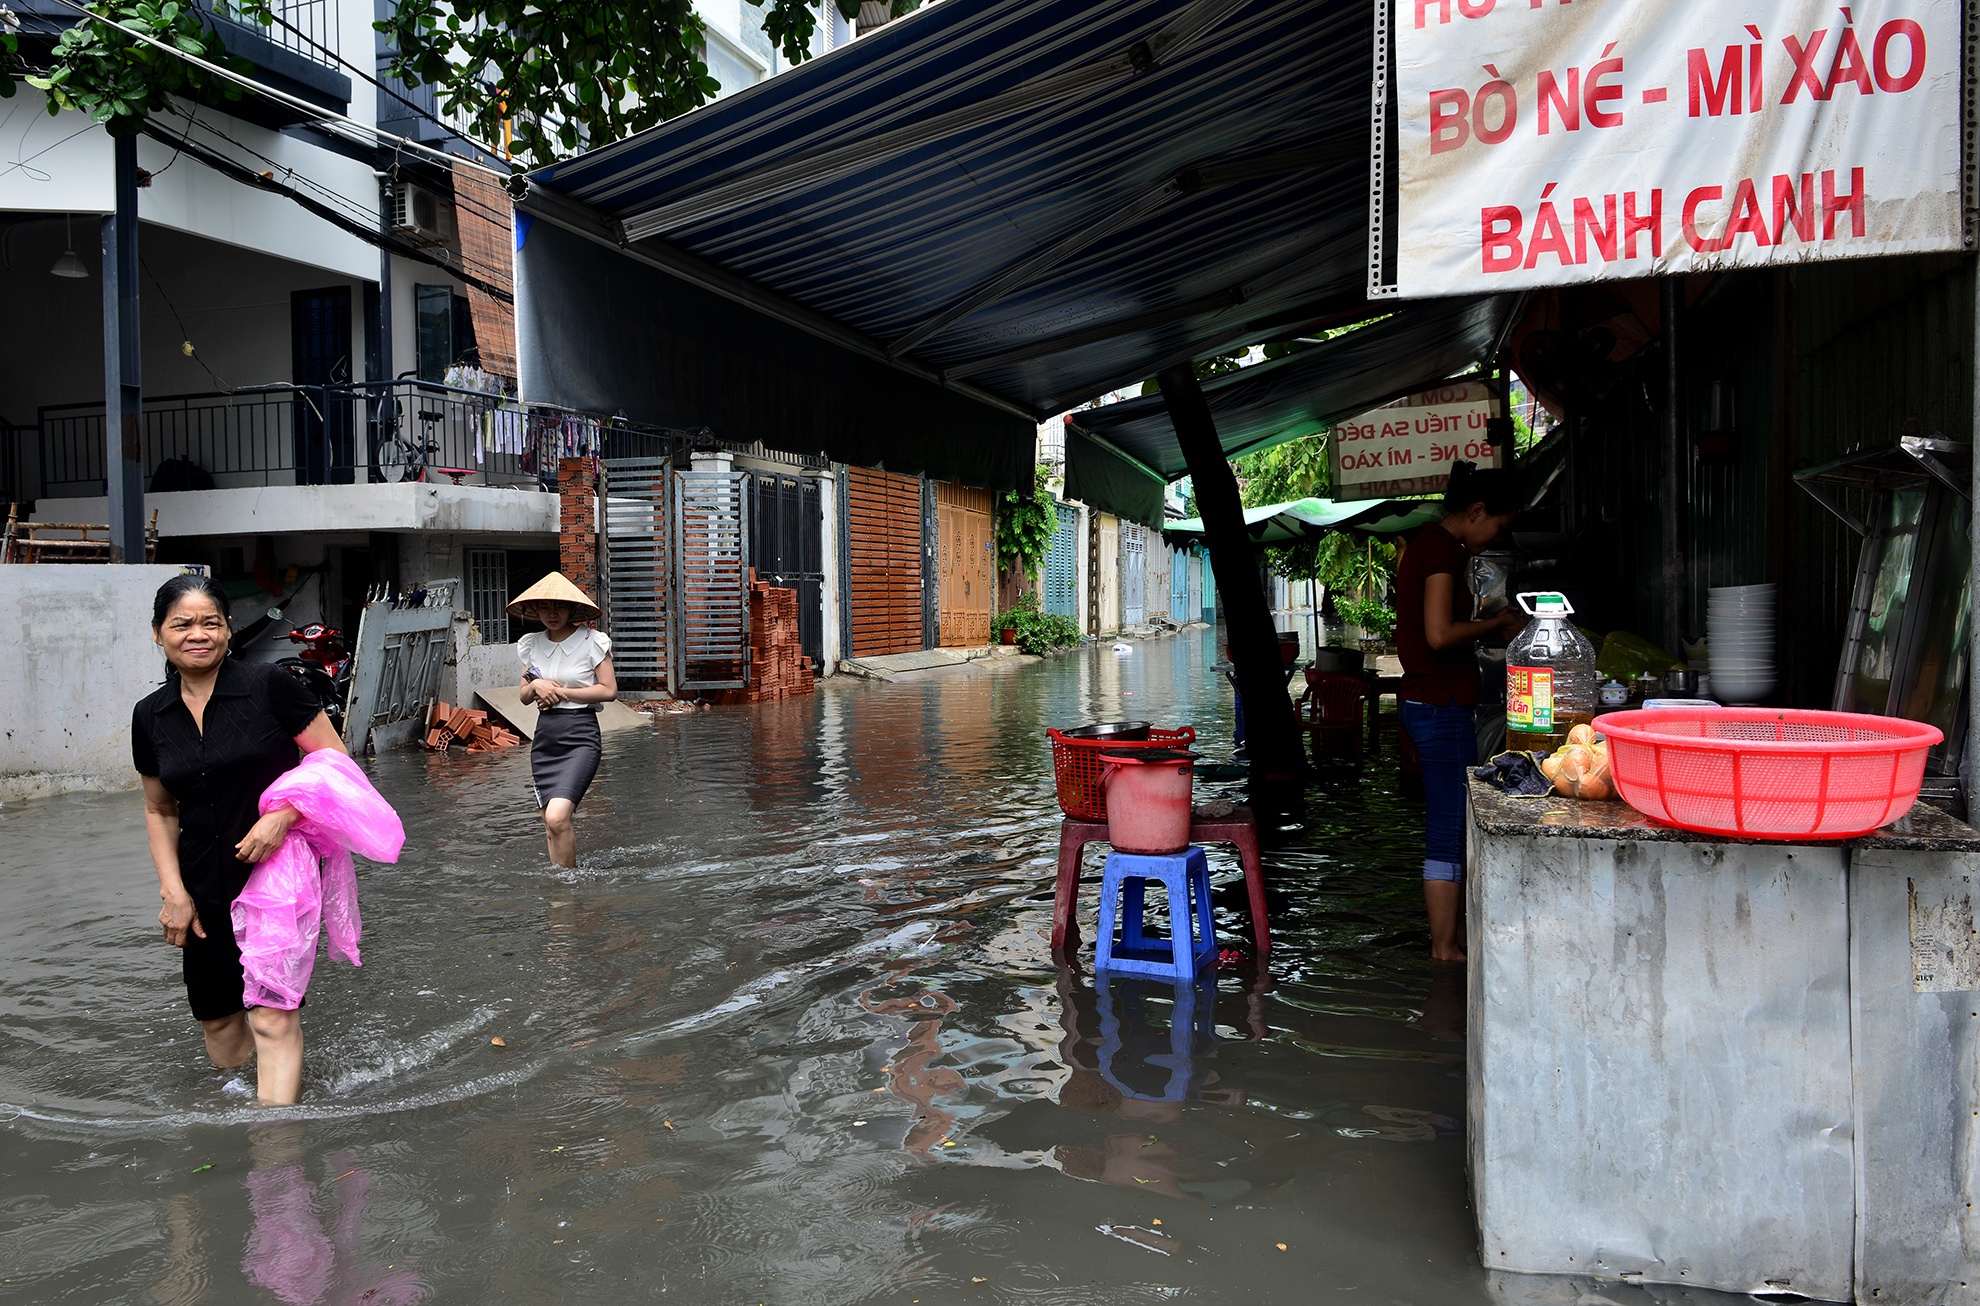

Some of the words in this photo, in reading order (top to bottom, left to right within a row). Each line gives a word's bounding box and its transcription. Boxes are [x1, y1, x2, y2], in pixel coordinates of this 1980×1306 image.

[1428, 63, 1518, 155] BÒ
[1536, 40, 1624, 136] NÉ
[1642, 87, 1668, 104] -
[1687, 24, 1763, 118] MÌ
[1780, 6, 1927, 106] XÀO
[1480, 182, 1662, 274] BÁNH
[1682, 166, 1866, 254] CANH
